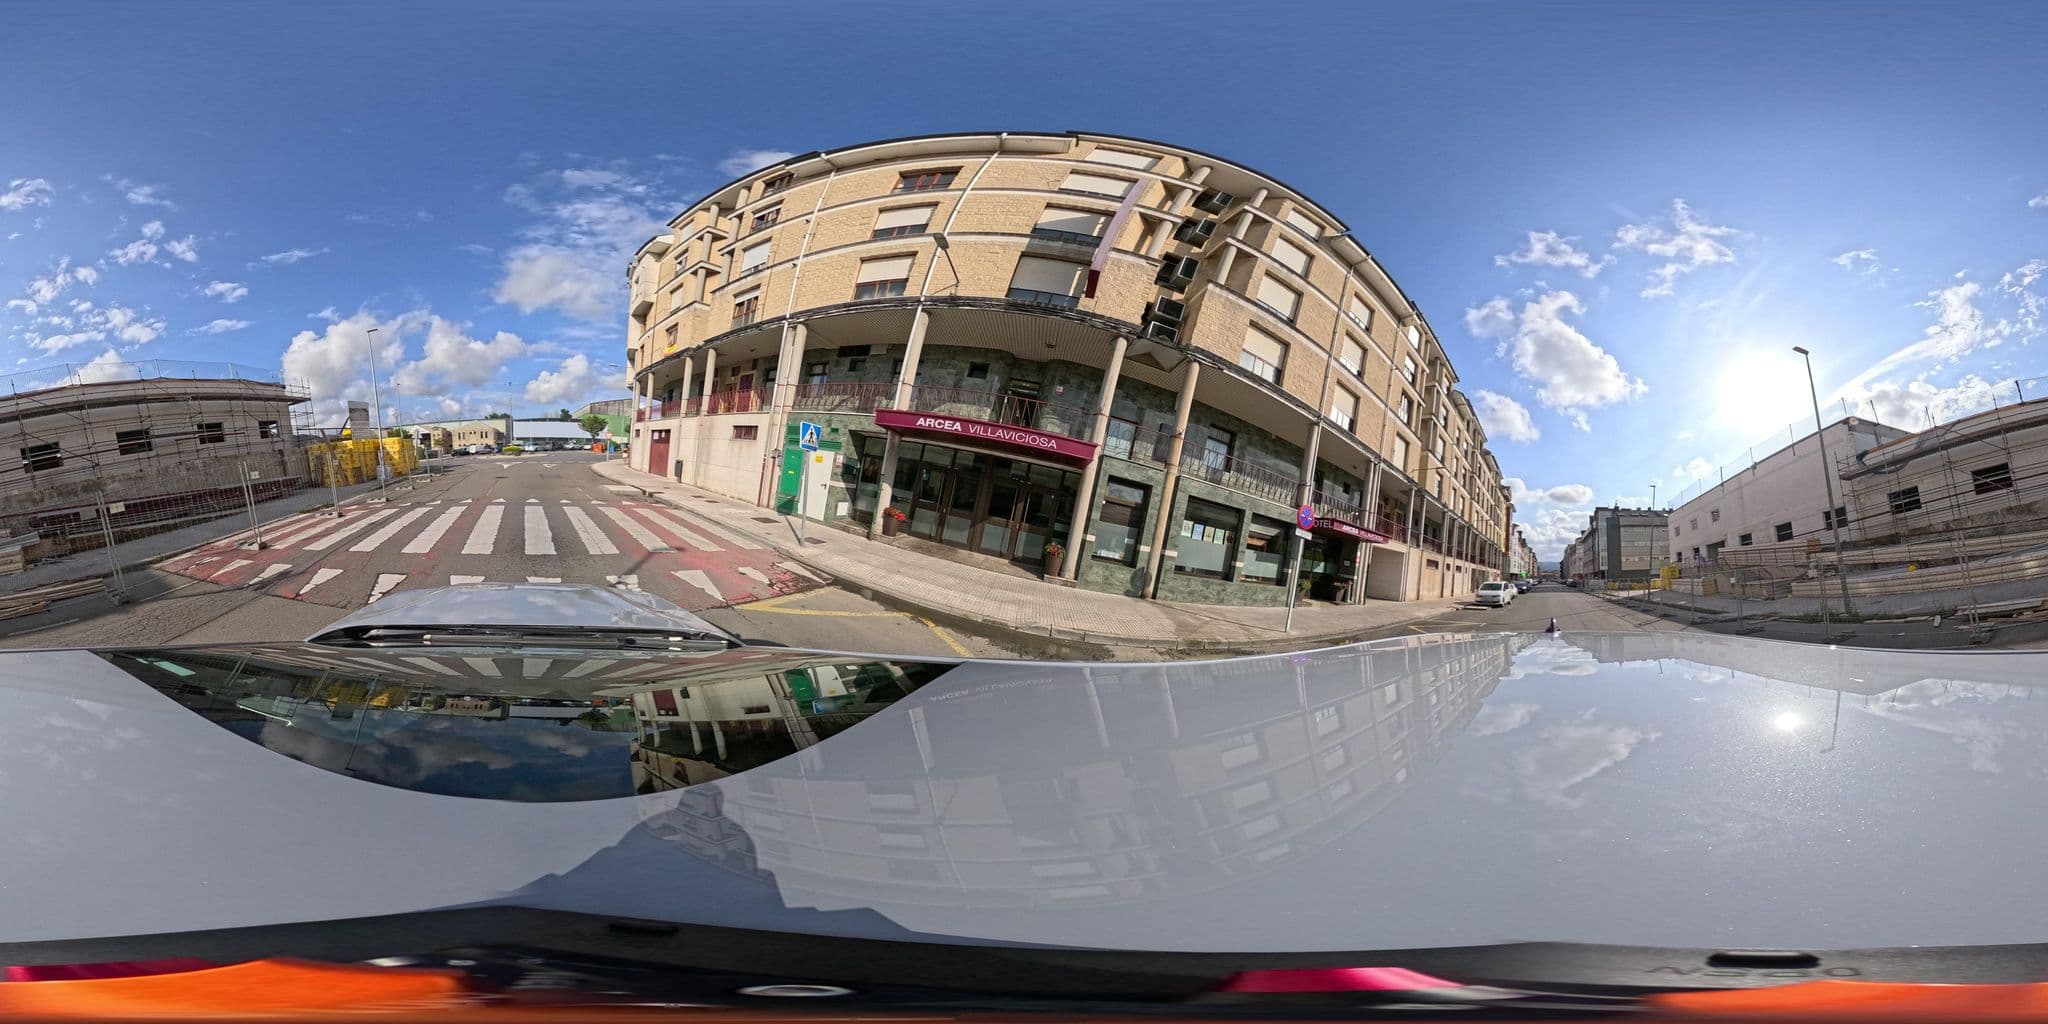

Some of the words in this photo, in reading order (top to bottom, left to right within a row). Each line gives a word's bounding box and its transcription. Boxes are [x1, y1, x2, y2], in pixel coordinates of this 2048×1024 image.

[916, 417, 962, 432] ARCEA
[968, 423, 1057, 449] VILLAVICIOSA
[1313, 520, 1333, 529] OTEL
